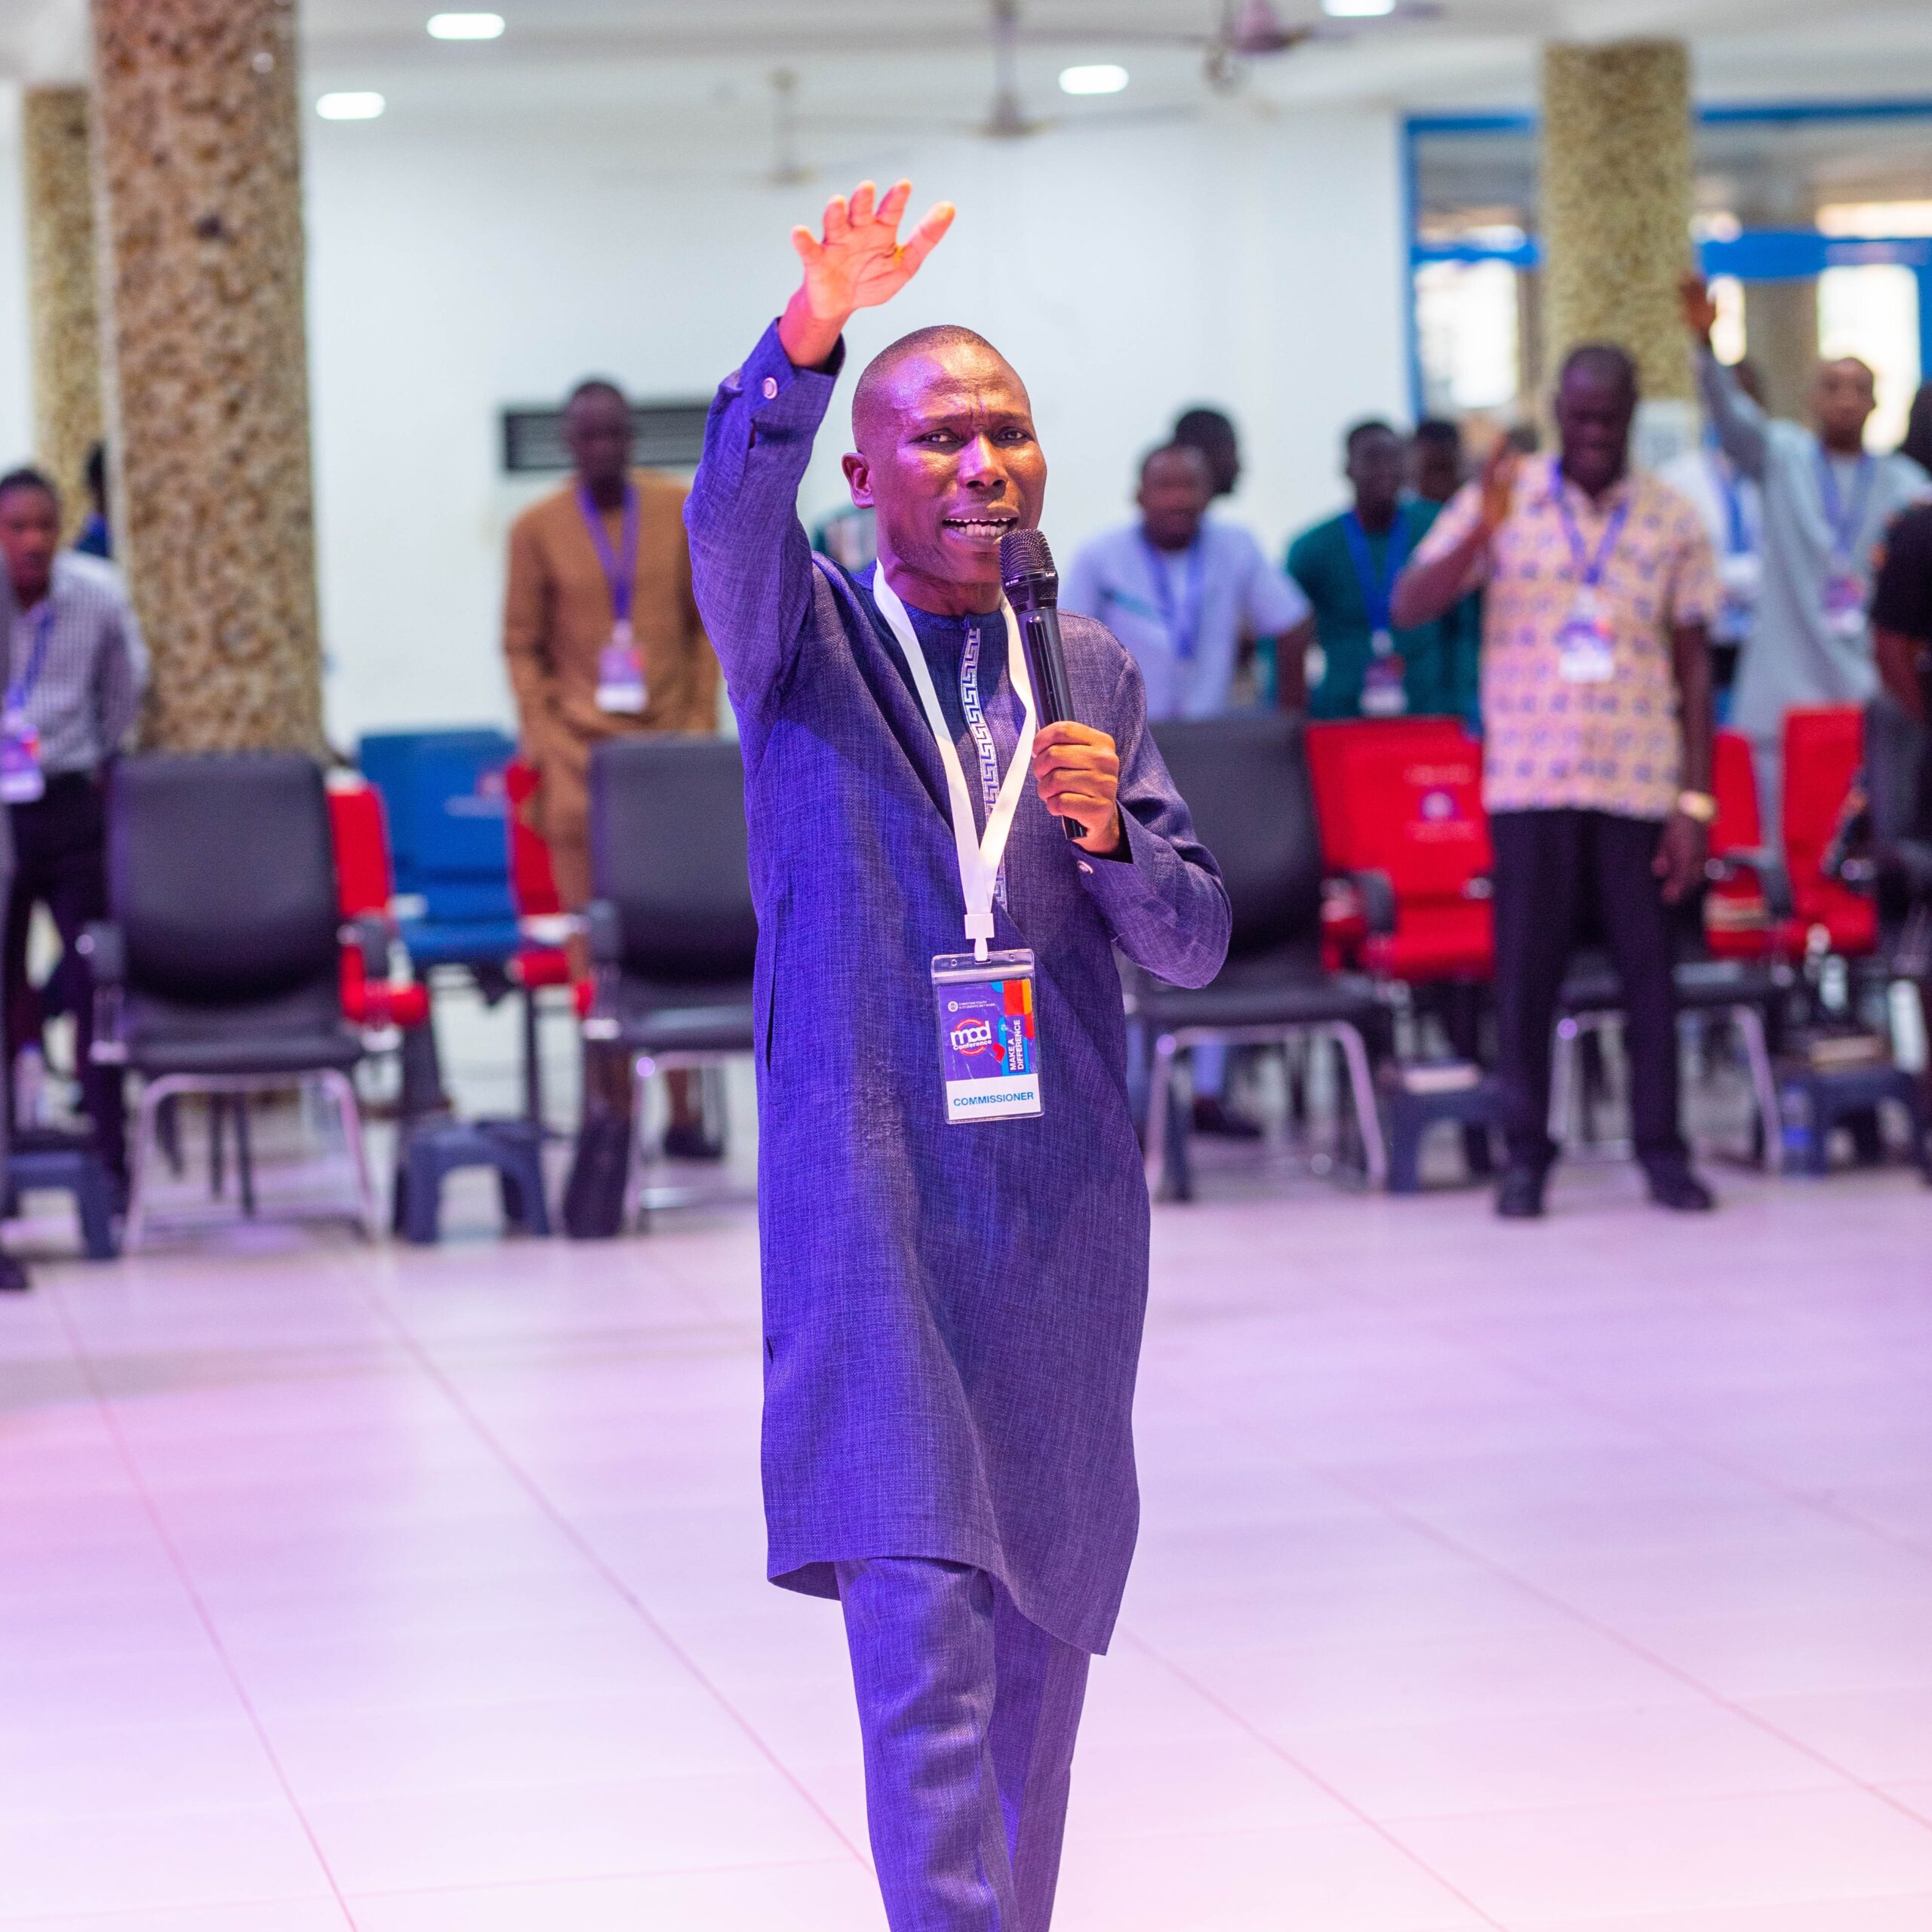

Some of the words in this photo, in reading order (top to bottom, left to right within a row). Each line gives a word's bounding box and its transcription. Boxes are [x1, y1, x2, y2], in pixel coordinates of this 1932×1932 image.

[953, 1040, 992, 1051] Conference
[1014, 1020, 1024, 1070] DIFFERENCE
[1008, 1046, 1017, 1071] MAKE
[953, 1091, 1034, 1106] COMMISSIONER
